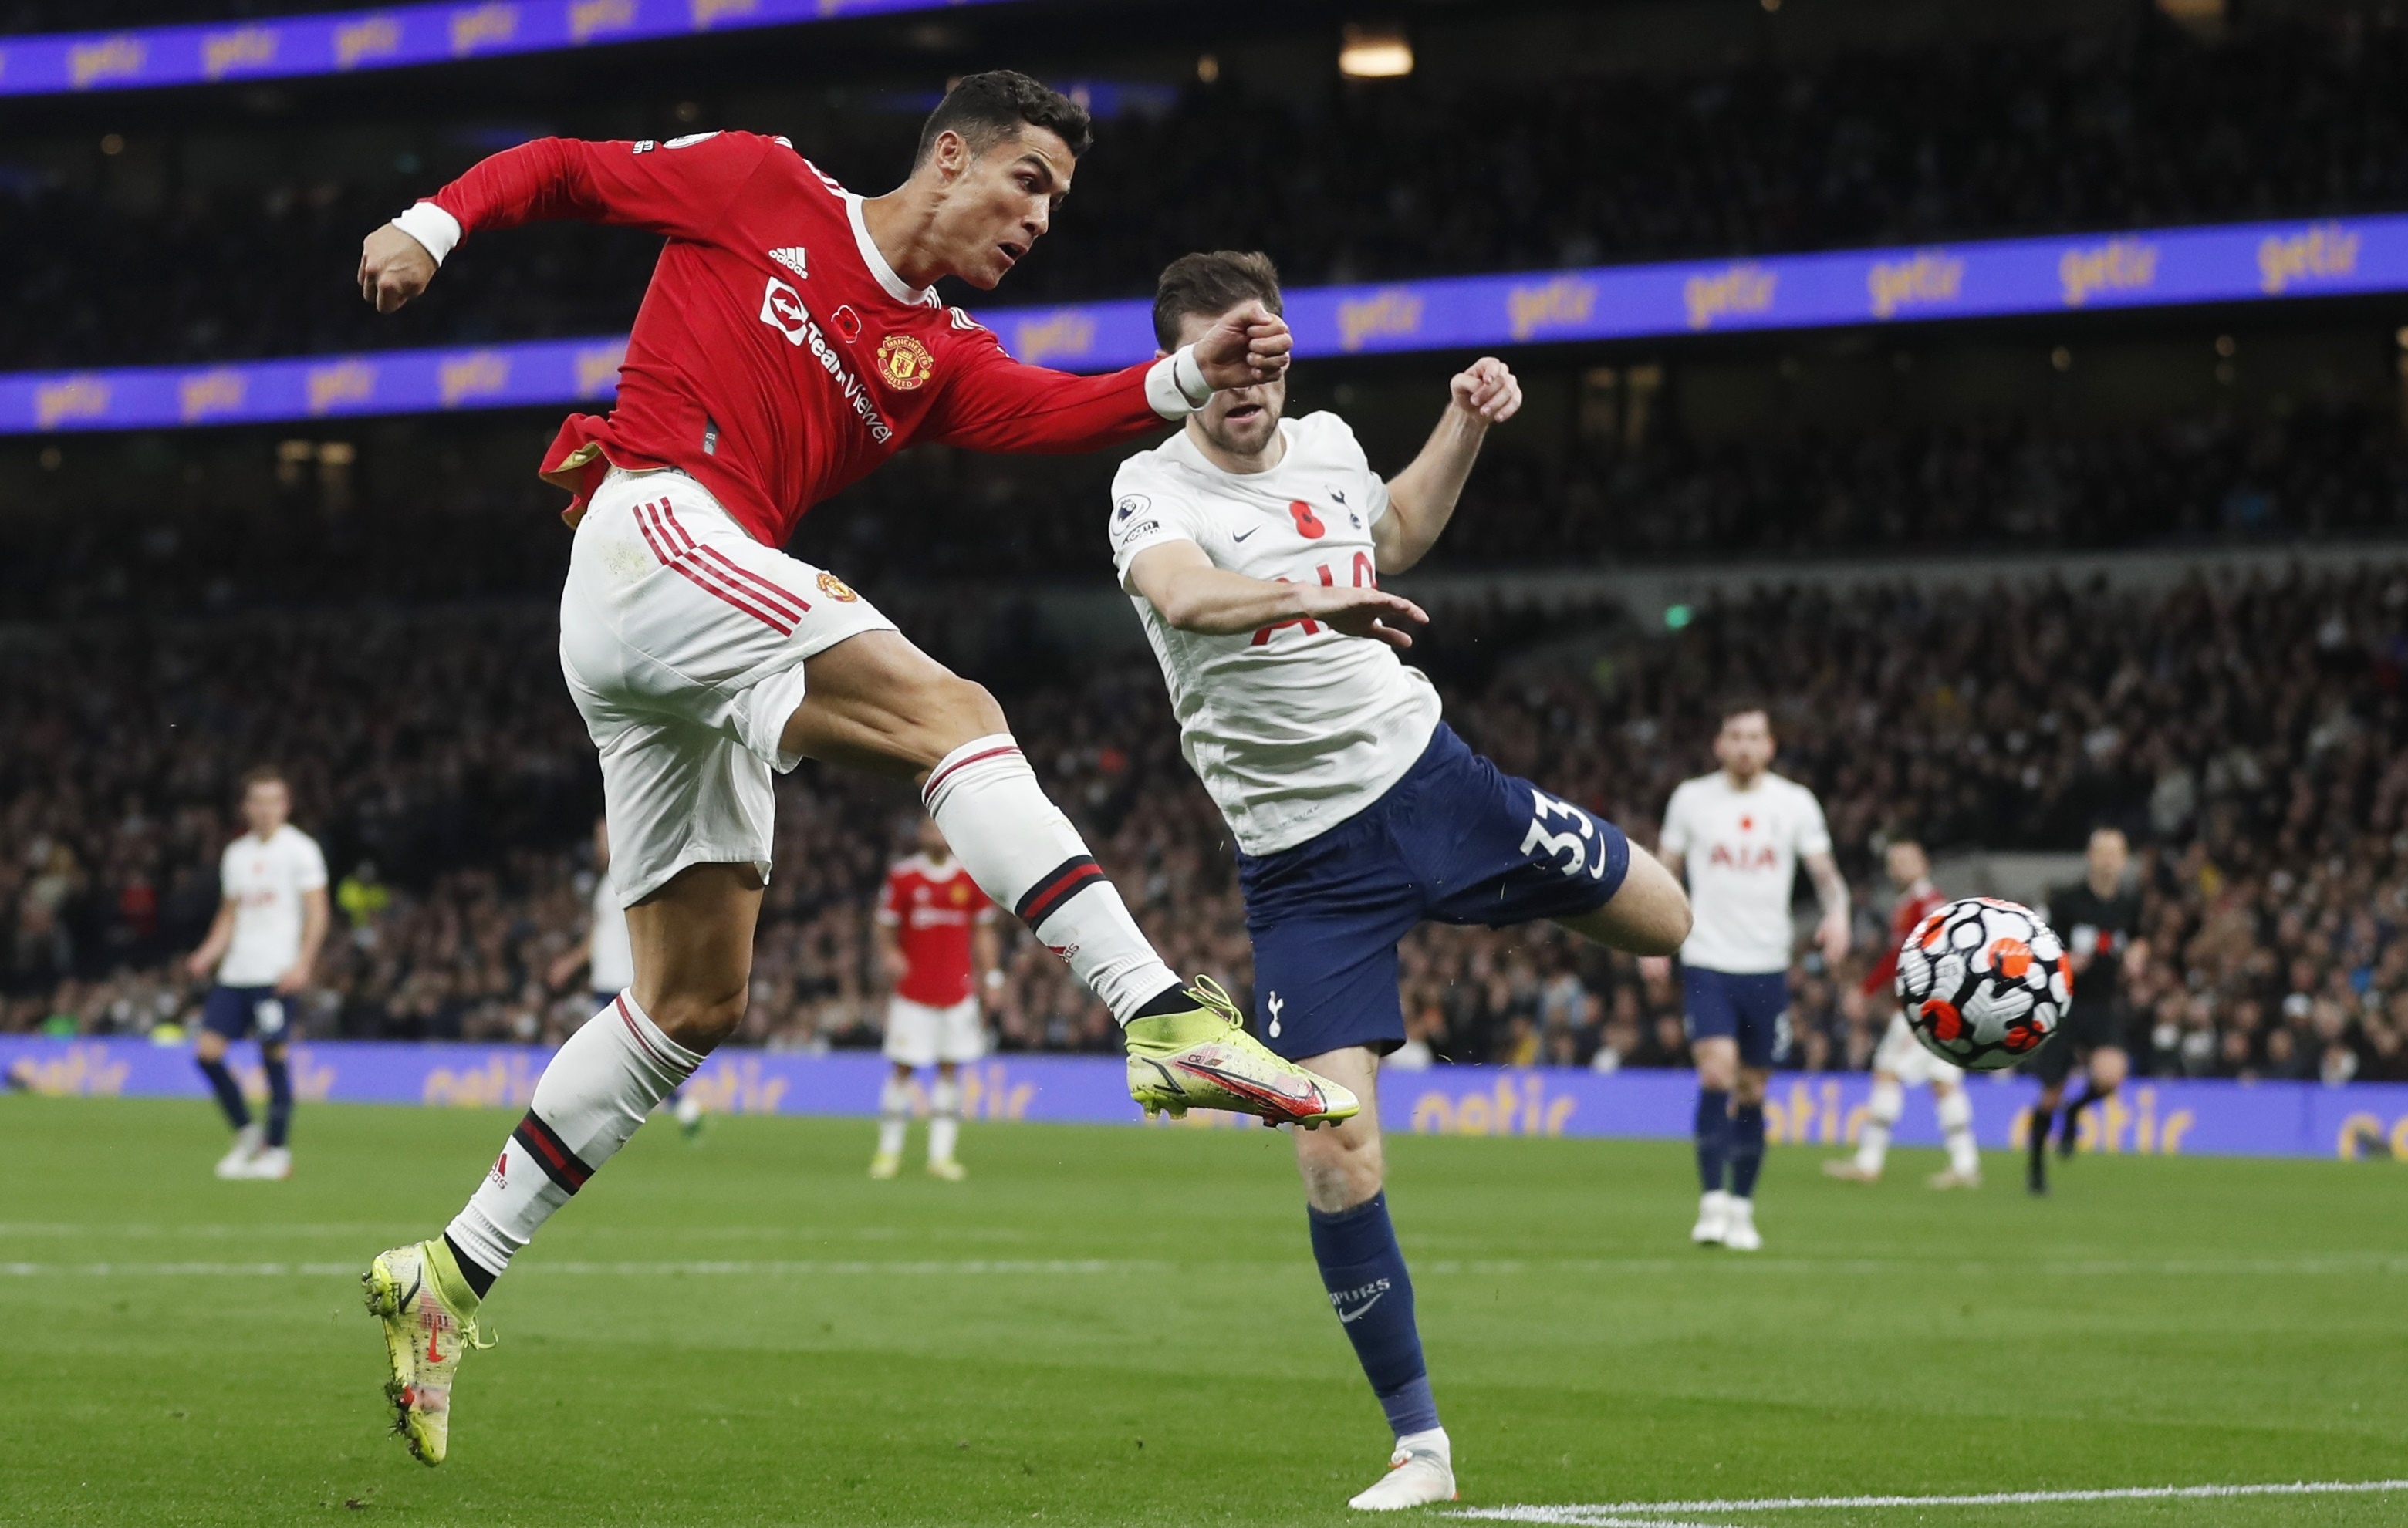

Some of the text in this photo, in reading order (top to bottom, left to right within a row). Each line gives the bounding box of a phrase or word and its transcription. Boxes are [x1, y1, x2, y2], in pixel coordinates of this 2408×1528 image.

[768, 248, 809, 279] adidas
[883, 369, 913, 387] UNITED
[1518, 788, 1594, 876] 33
